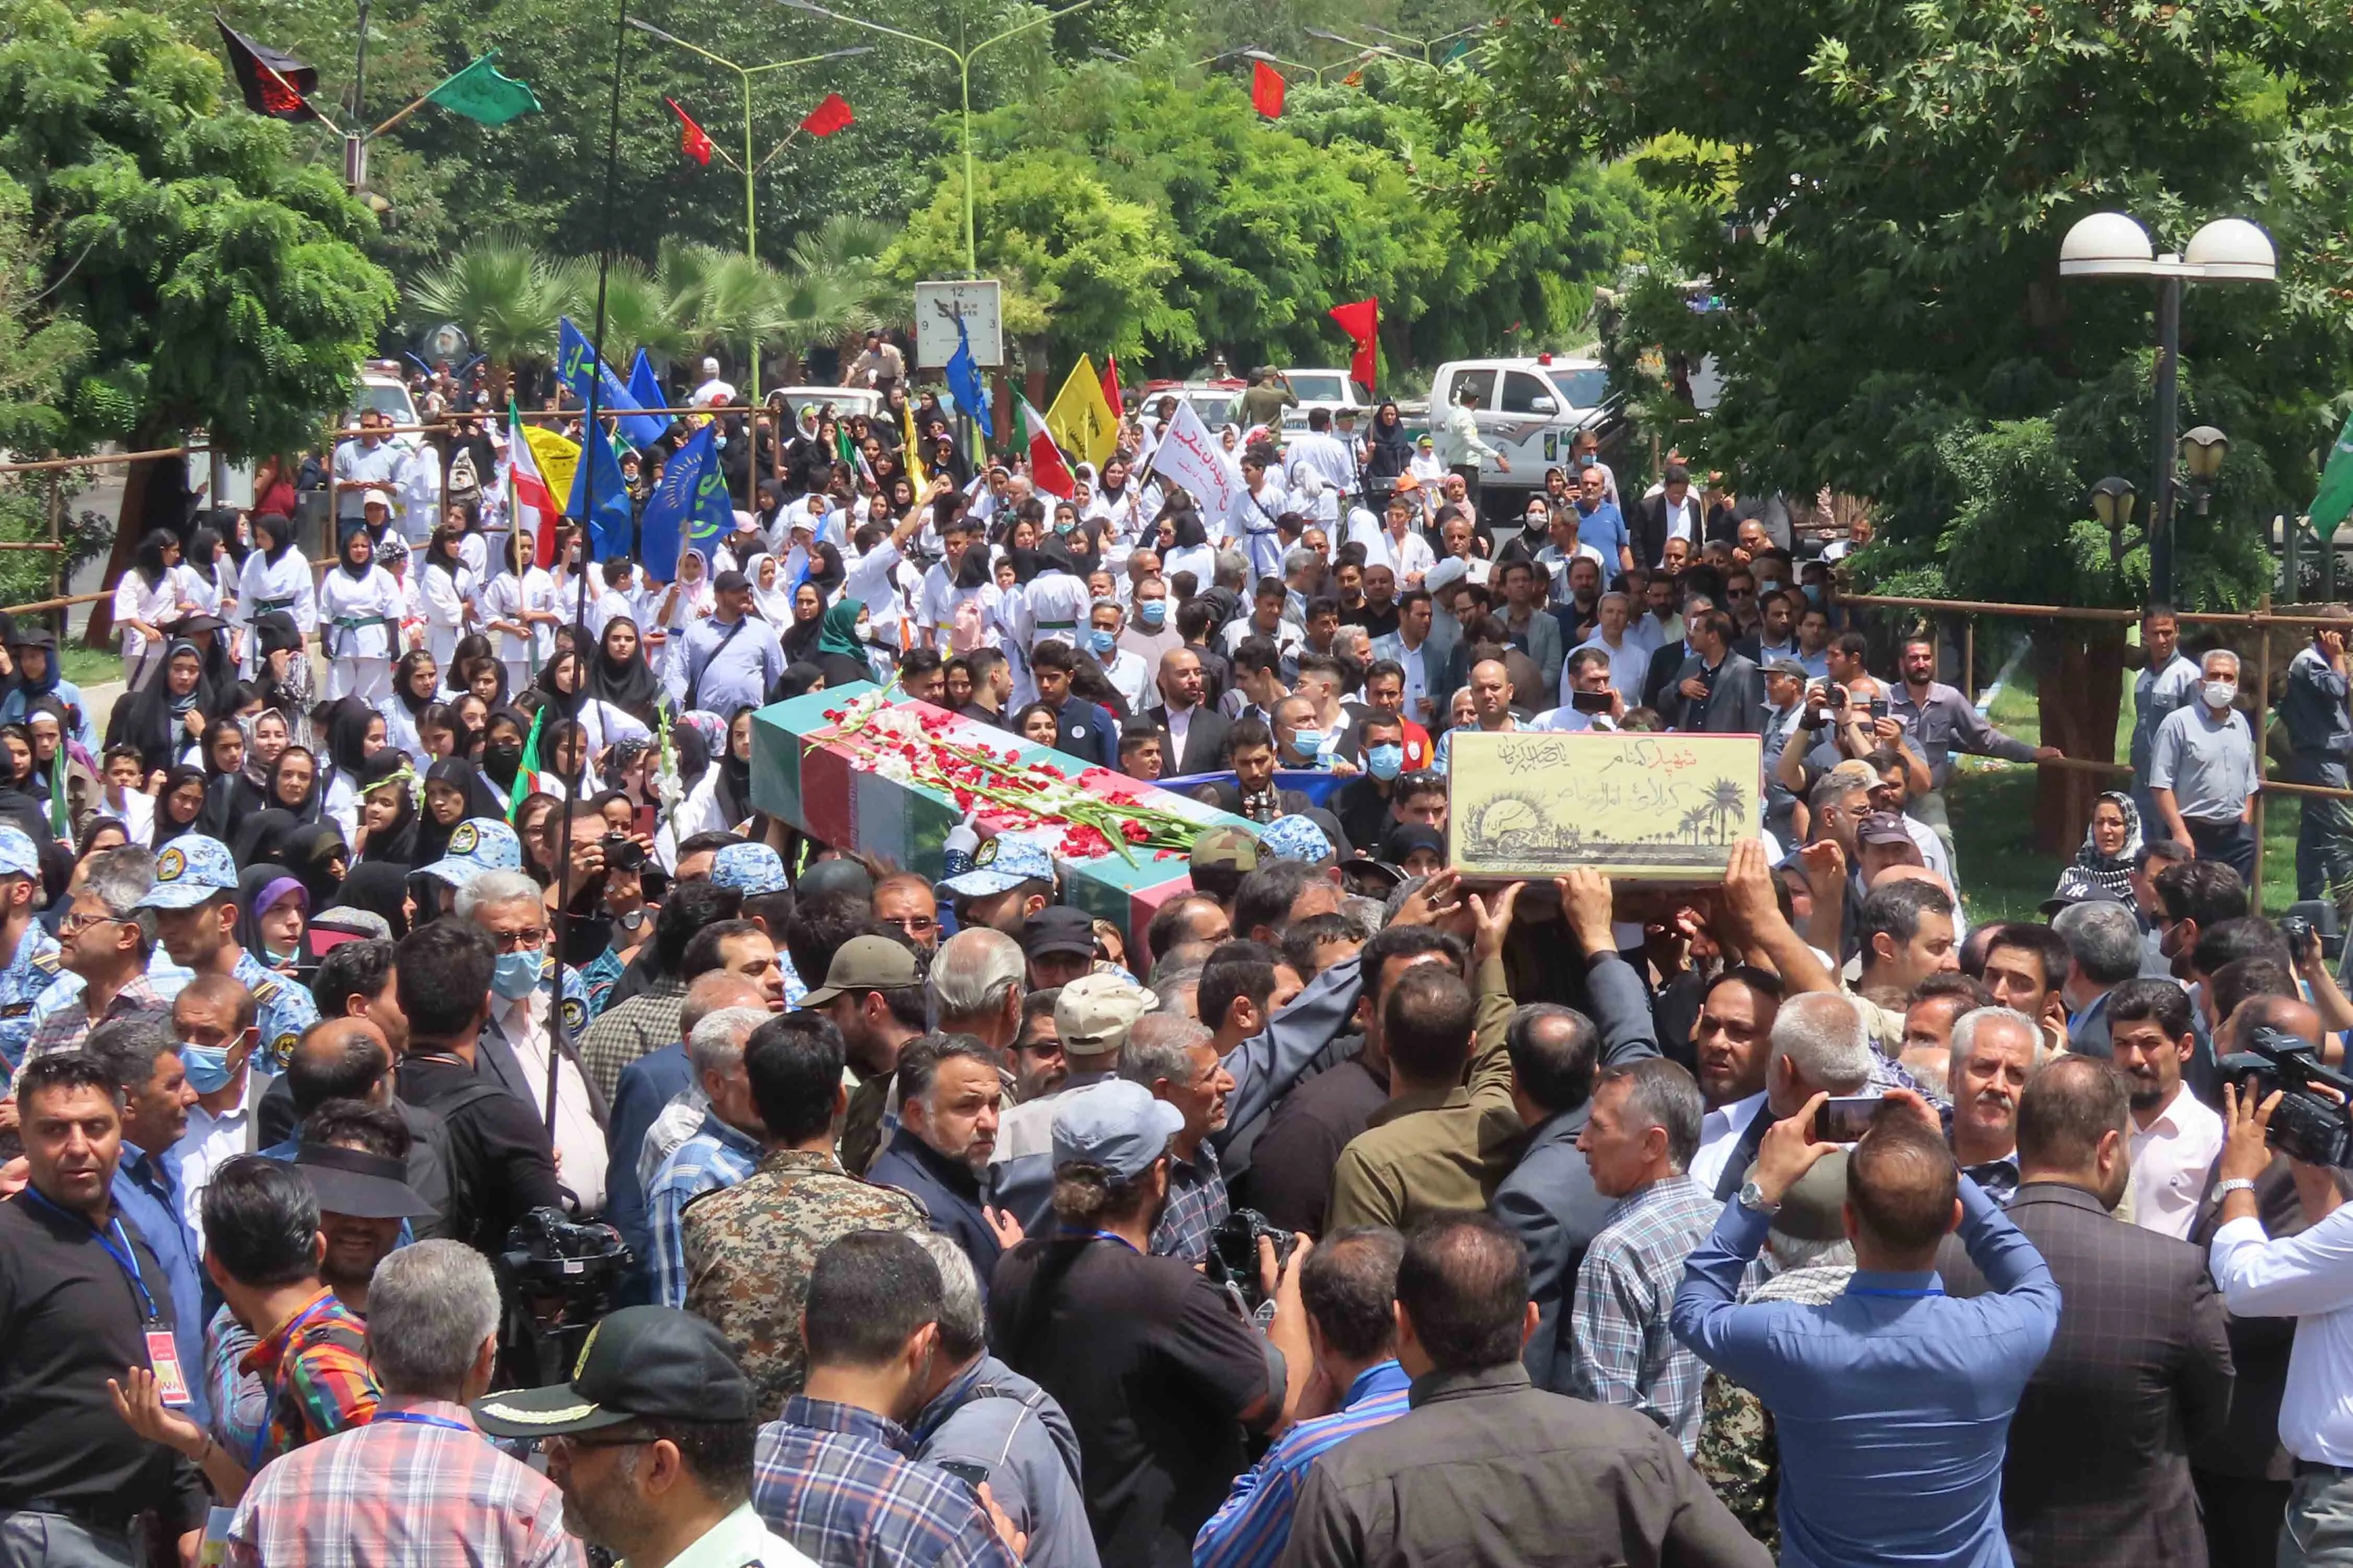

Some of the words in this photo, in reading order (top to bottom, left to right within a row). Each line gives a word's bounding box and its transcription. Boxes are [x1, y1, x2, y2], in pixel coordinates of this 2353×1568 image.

[951, 287, 964, 297] 12
[922, 320, 929, 330] 9
[989, 319, 996, 329] 3
[1647, 746, 1697, 777] شهید
